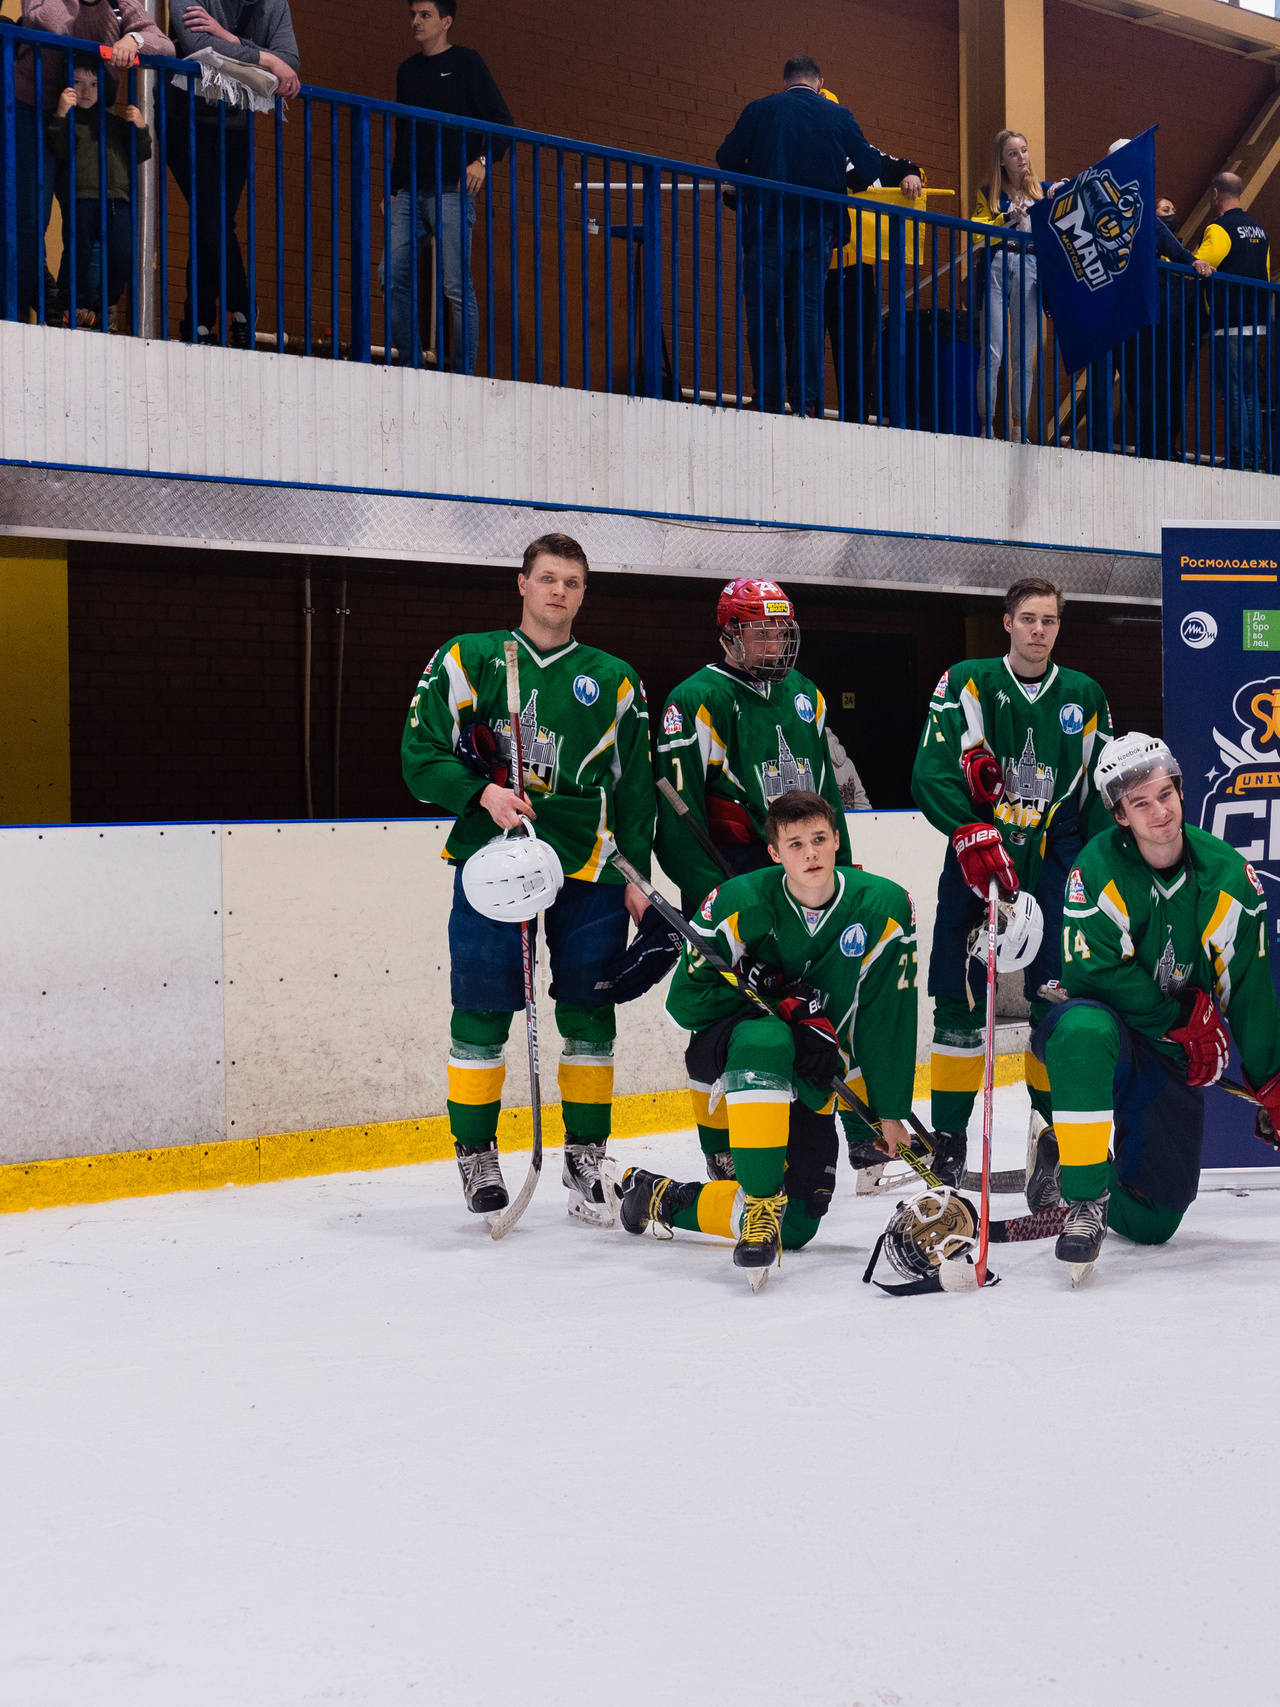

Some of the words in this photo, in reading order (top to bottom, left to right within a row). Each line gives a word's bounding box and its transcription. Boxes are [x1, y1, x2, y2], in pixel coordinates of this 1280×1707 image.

[1054, 192, 1107, 285] MADI
[1061, 234, 1084, 277] MOTORS
[1181, 556, 1278, 569] Росмолодежь
[1253, 612, 1266, 621] До
[1253, 622, 1269, 632] бро
[1253, 640, 1269, 648] лец
[511, 740, 519, 785] BAUER
[1063, 926, 1091, 962] 14
[520, 928, 532, 1002] VAPOR
